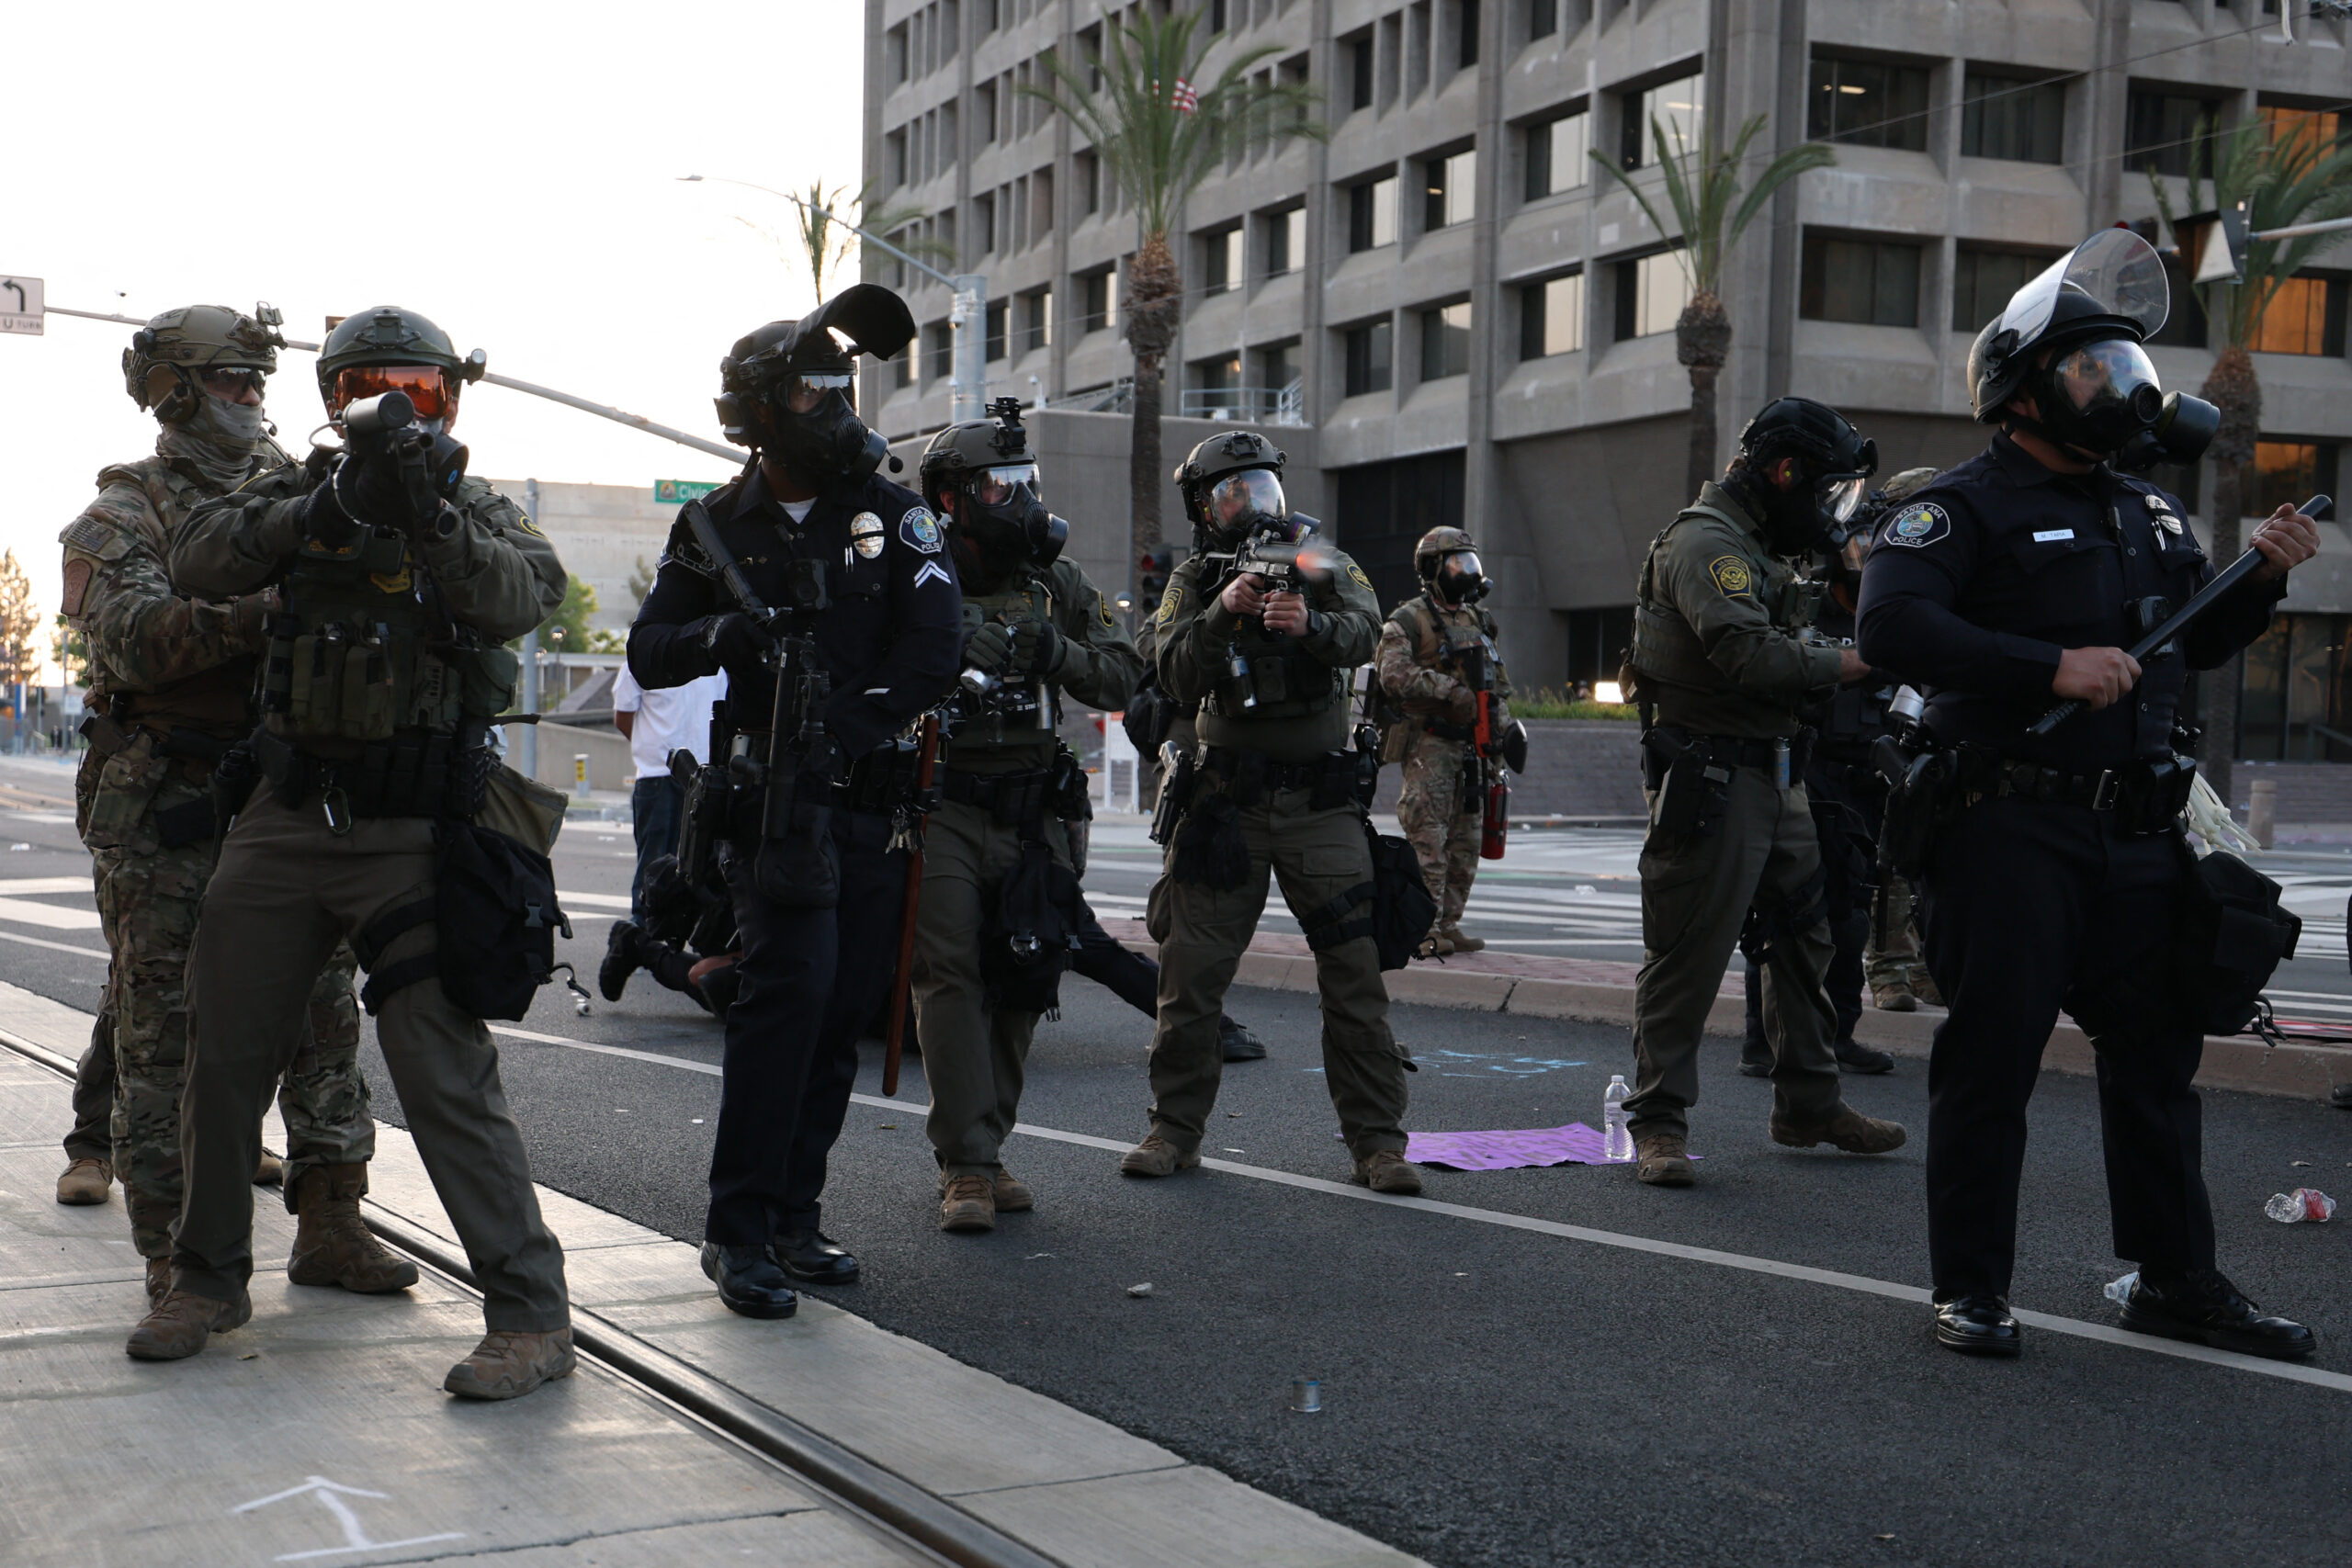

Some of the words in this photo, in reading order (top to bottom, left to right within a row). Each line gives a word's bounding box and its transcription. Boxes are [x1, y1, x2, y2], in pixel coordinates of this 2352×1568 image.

[4, 317, 14, 329] U
[17, 320, 43, 330] TURN
[905, 509, 923, 525] SANTA
[1897, 504, 1925, 520] SANTA
[1927, 505, 1944, 520] ANA
[1893, 536, 1923, 546] POLICE
